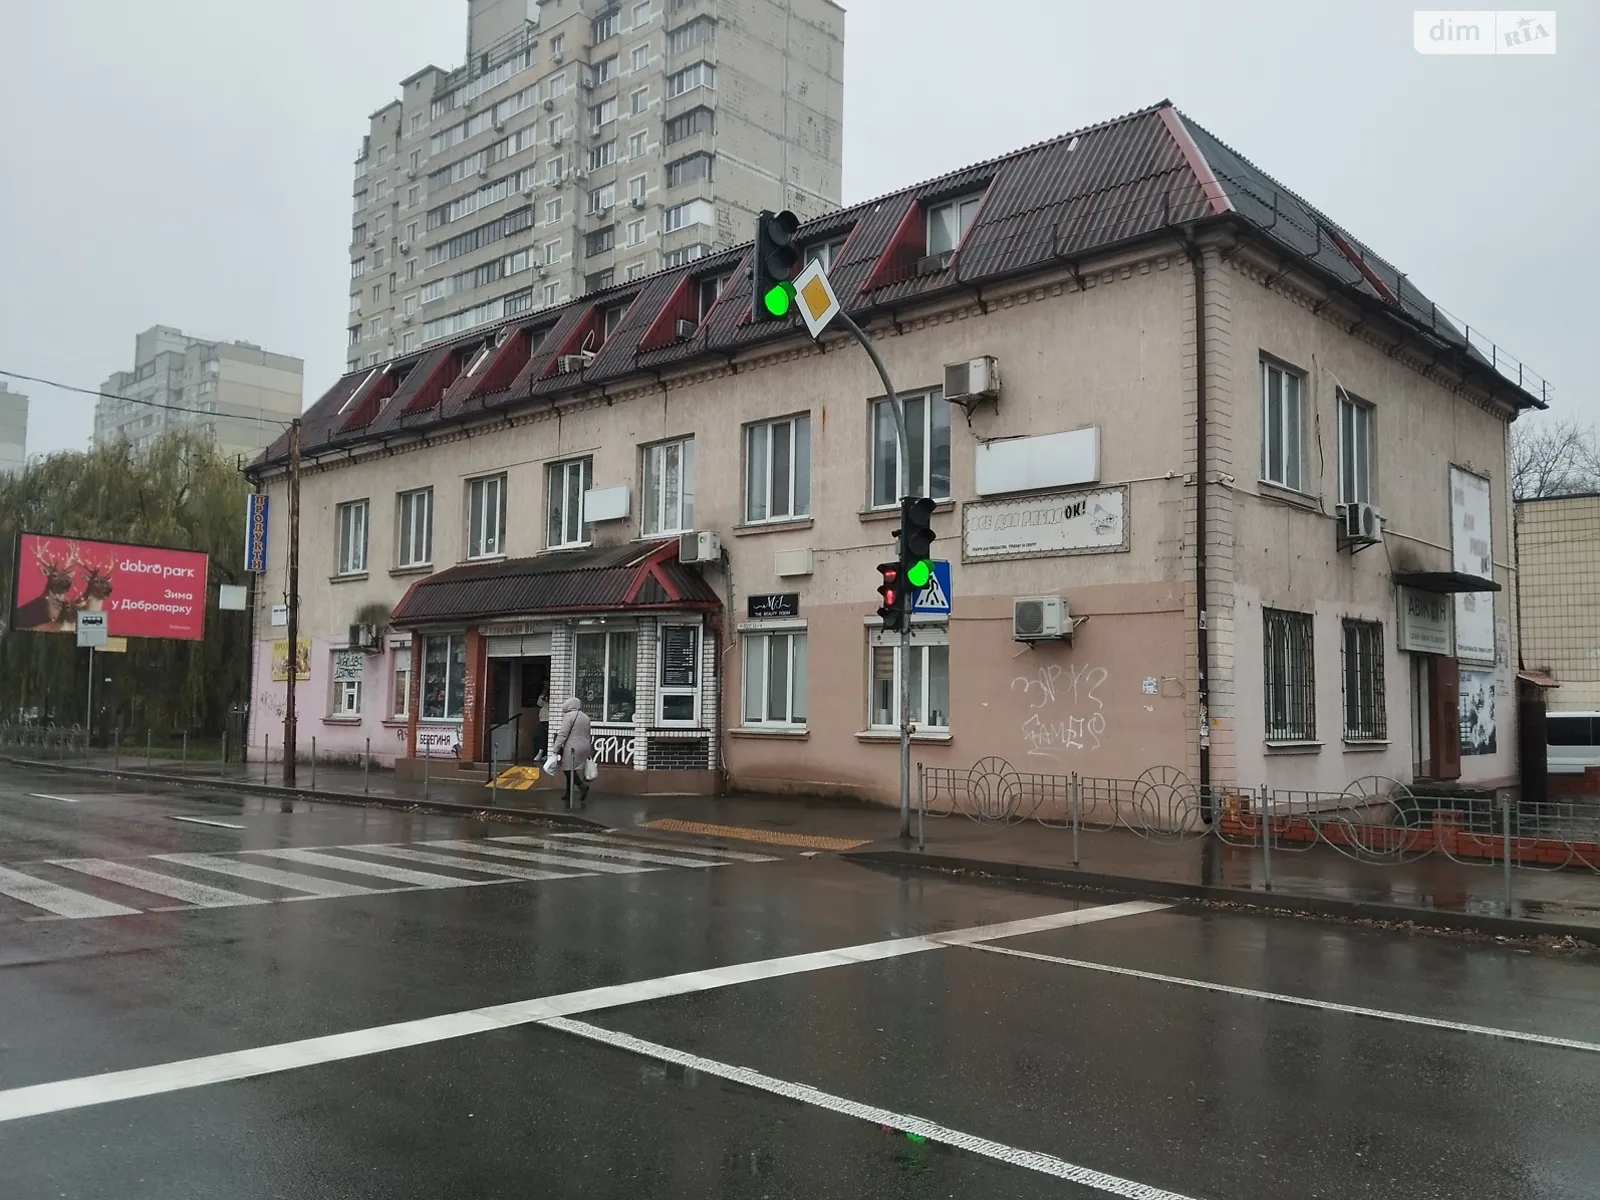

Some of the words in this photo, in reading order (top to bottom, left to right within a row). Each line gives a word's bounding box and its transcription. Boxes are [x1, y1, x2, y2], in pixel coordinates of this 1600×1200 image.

[252, 494, 266, 570] ПРОДУКТИ
[164, 589, 193, 601] Зима
[111, 600, 119, 610] у
[121, 599, 192, 616] Добропарку
[419, 734, 451, 746] БЕРЕГИНЯ
